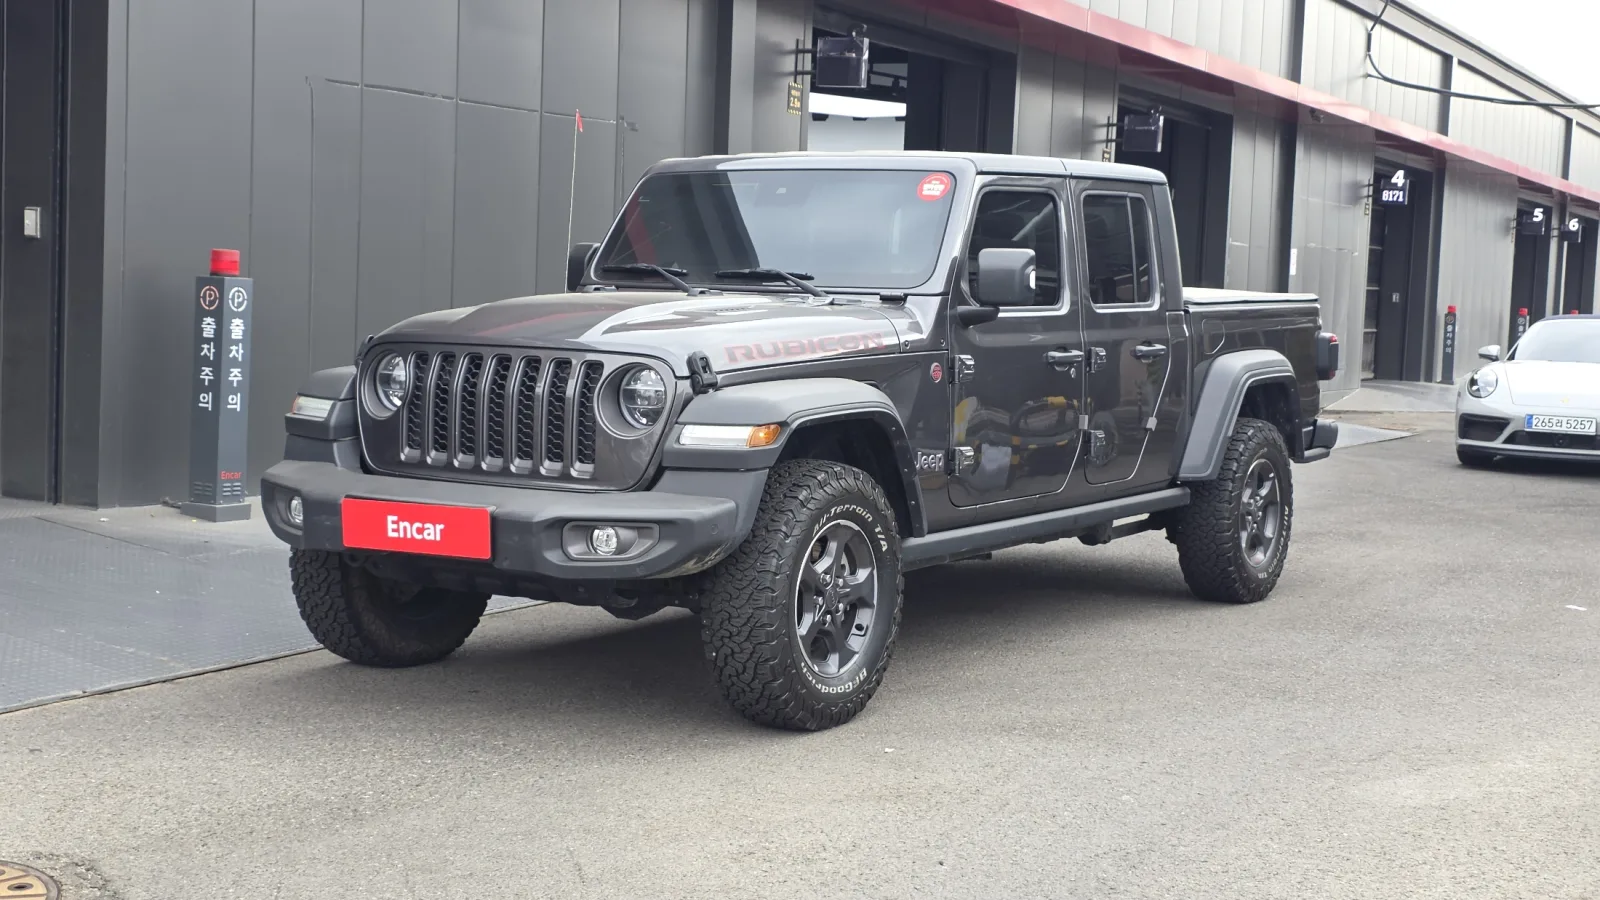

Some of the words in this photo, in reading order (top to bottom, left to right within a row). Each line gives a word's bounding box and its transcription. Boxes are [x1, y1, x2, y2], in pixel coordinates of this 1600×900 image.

[1391, 170, 1405, 187] 4
[1382, 190, 1404, 202] 8171
[1532, 208, 1544, 222] 5
[1568, 218, 1579, 231] 6
[723, 332, 886, 363] RUBICON
[199, 316, 216, 411] 출차주의
[227, 317, 245, 412] 출차주의
[1566, 419, 1594, 430] 5257
[915, 451, 944, 472] Jeep
[220, 470, 242, 480] Encar
[386, 515, 445, 541] Encar
[812, 503, 874, 537] All-Terrain
[874, 523, 889, 553] T/A
[800, 661, 868, 694] BFGoodrich
